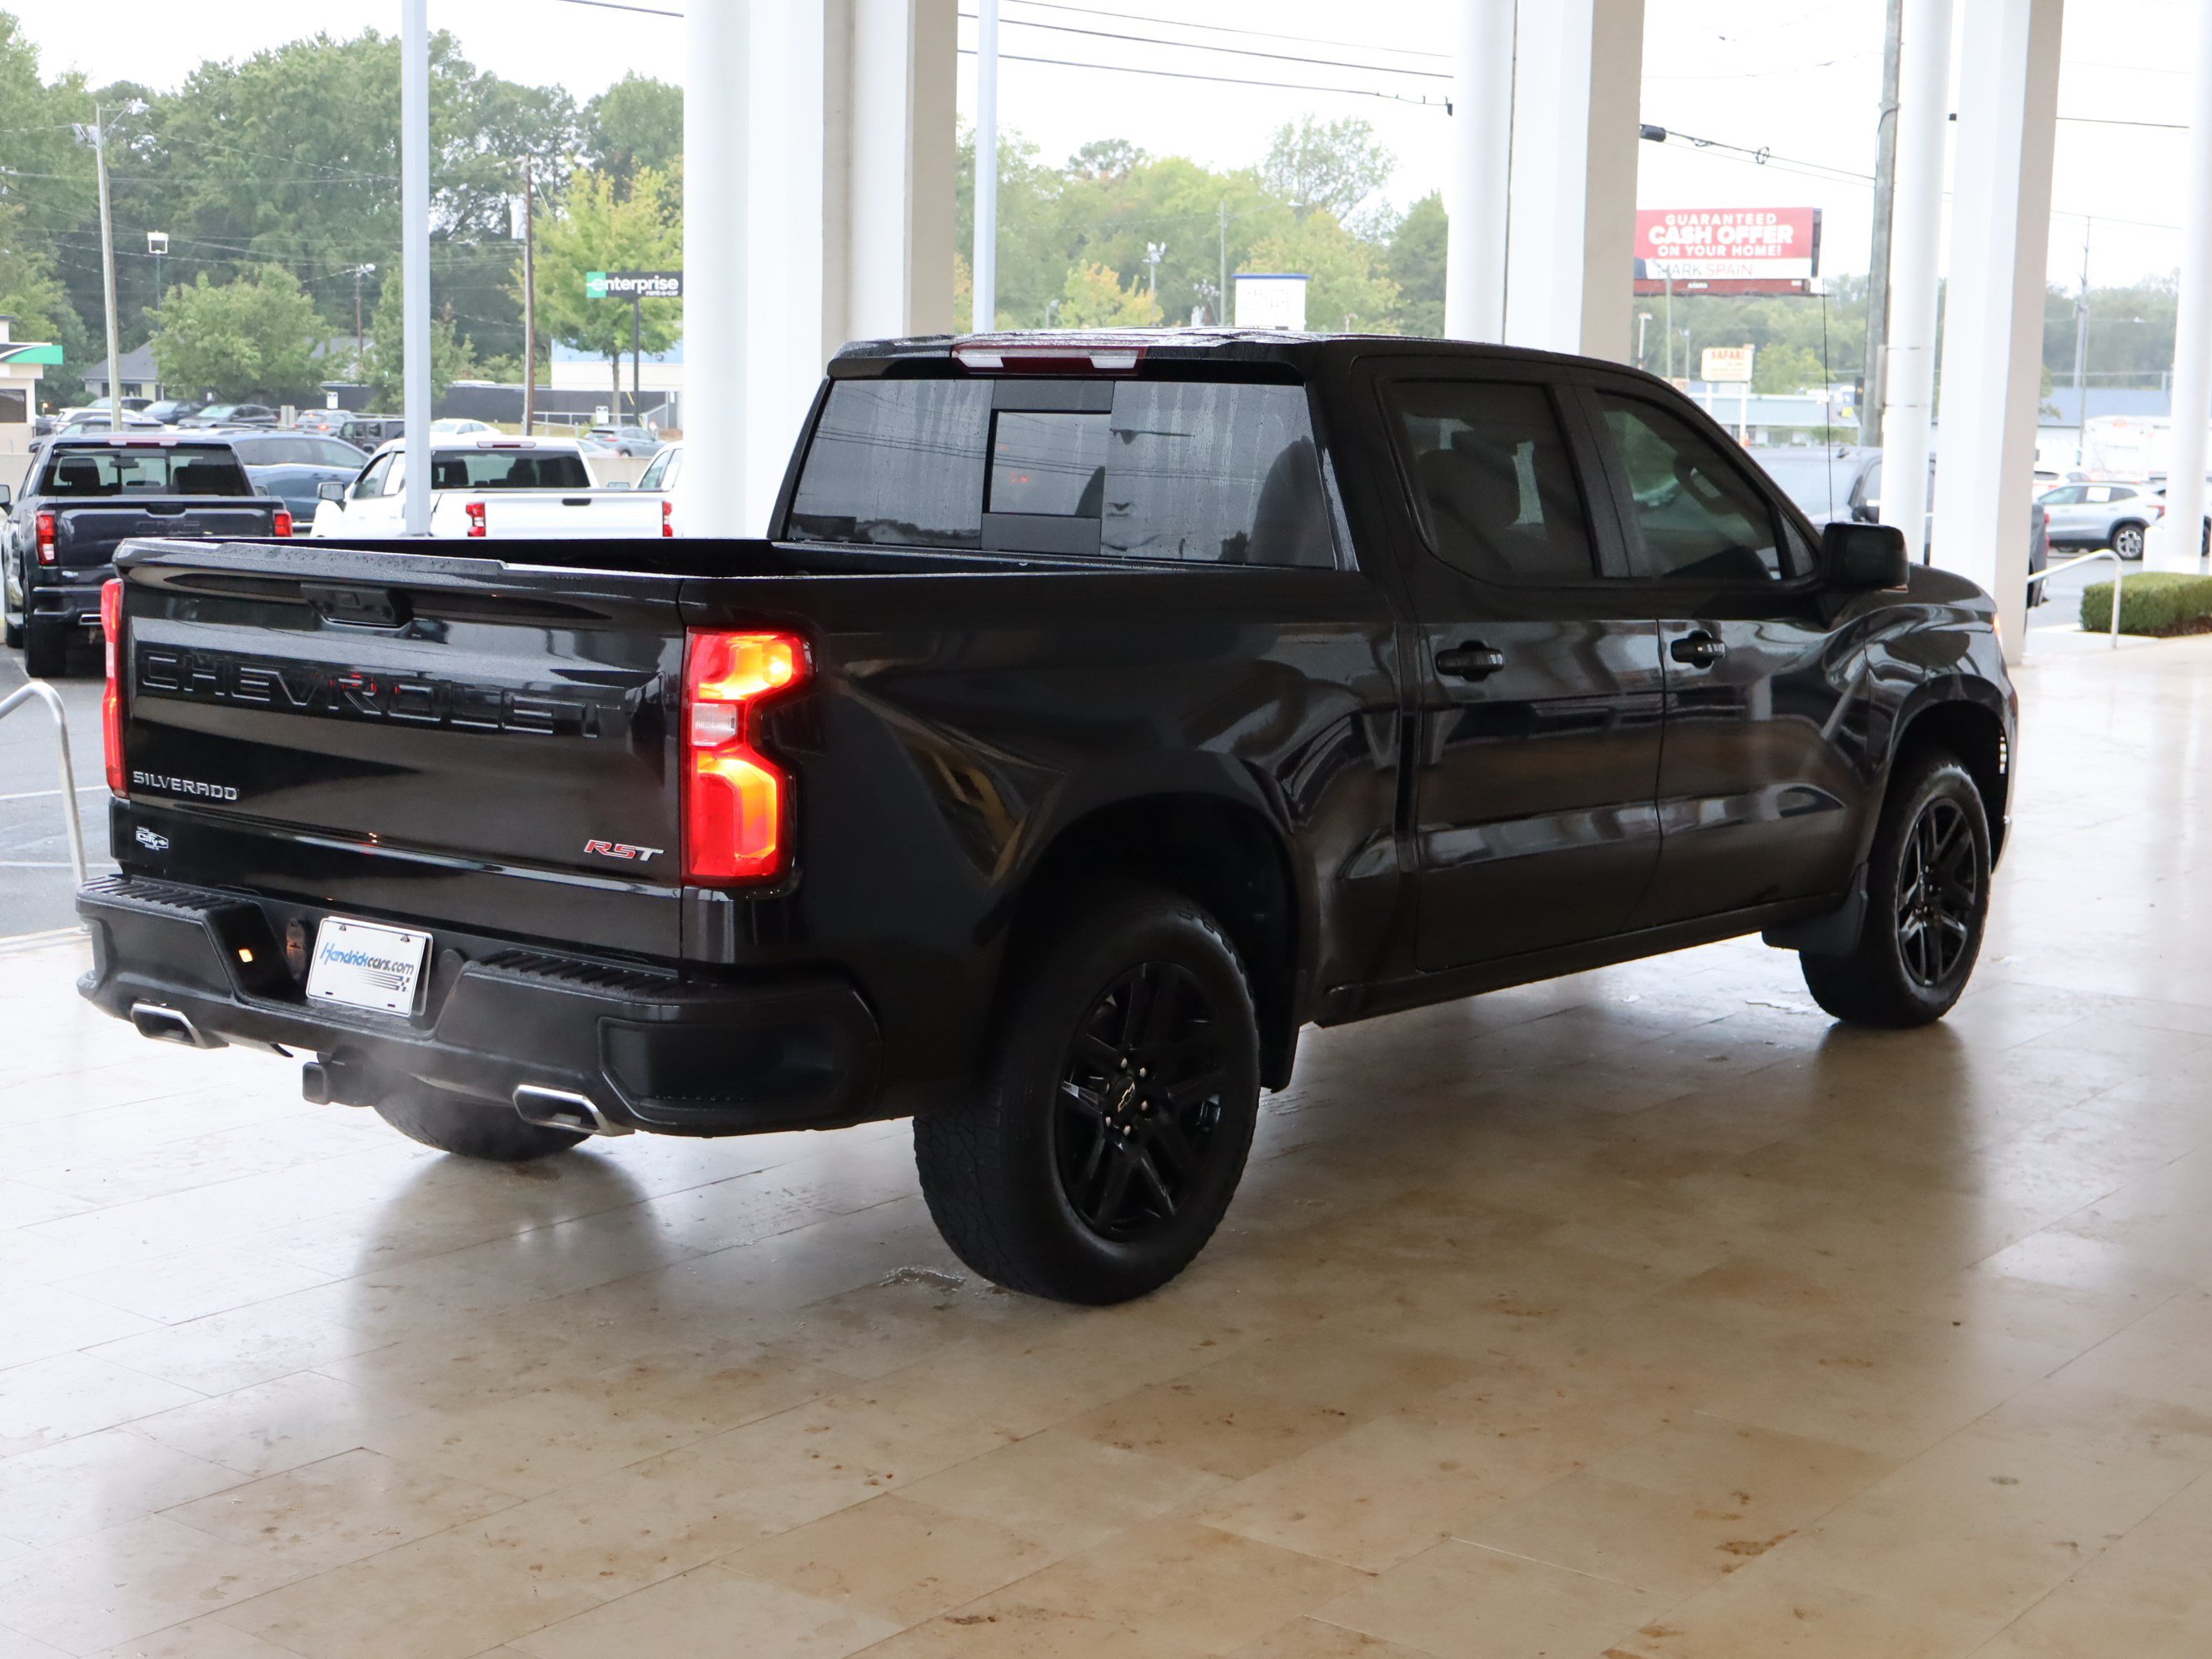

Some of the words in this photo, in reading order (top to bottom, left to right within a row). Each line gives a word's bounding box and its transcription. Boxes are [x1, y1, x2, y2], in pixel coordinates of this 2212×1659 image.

[1665, 213, 1777, 226] GUARANTEED
[1648, 226, 1711, 244] CASH
[1716, 225, 1794, 244] OFFER
[1657, 245, 1679, 257] ON
[1684, 245, 1726, 257] YOUR
[1731, 244, 1781, 257] HOME!
[1657, 264, 1701, 276] MARK
[1706, 263, 1753, 276] SPAIN
[586, 275, 679, 294] enterprise
[142, 649, 620, 738] CHEVROLET
[133, 771, 237, 800] SILVERADO
[584, 839, 664, 861] RST
[320, 942, 414, 975] Hendrickcars.com
